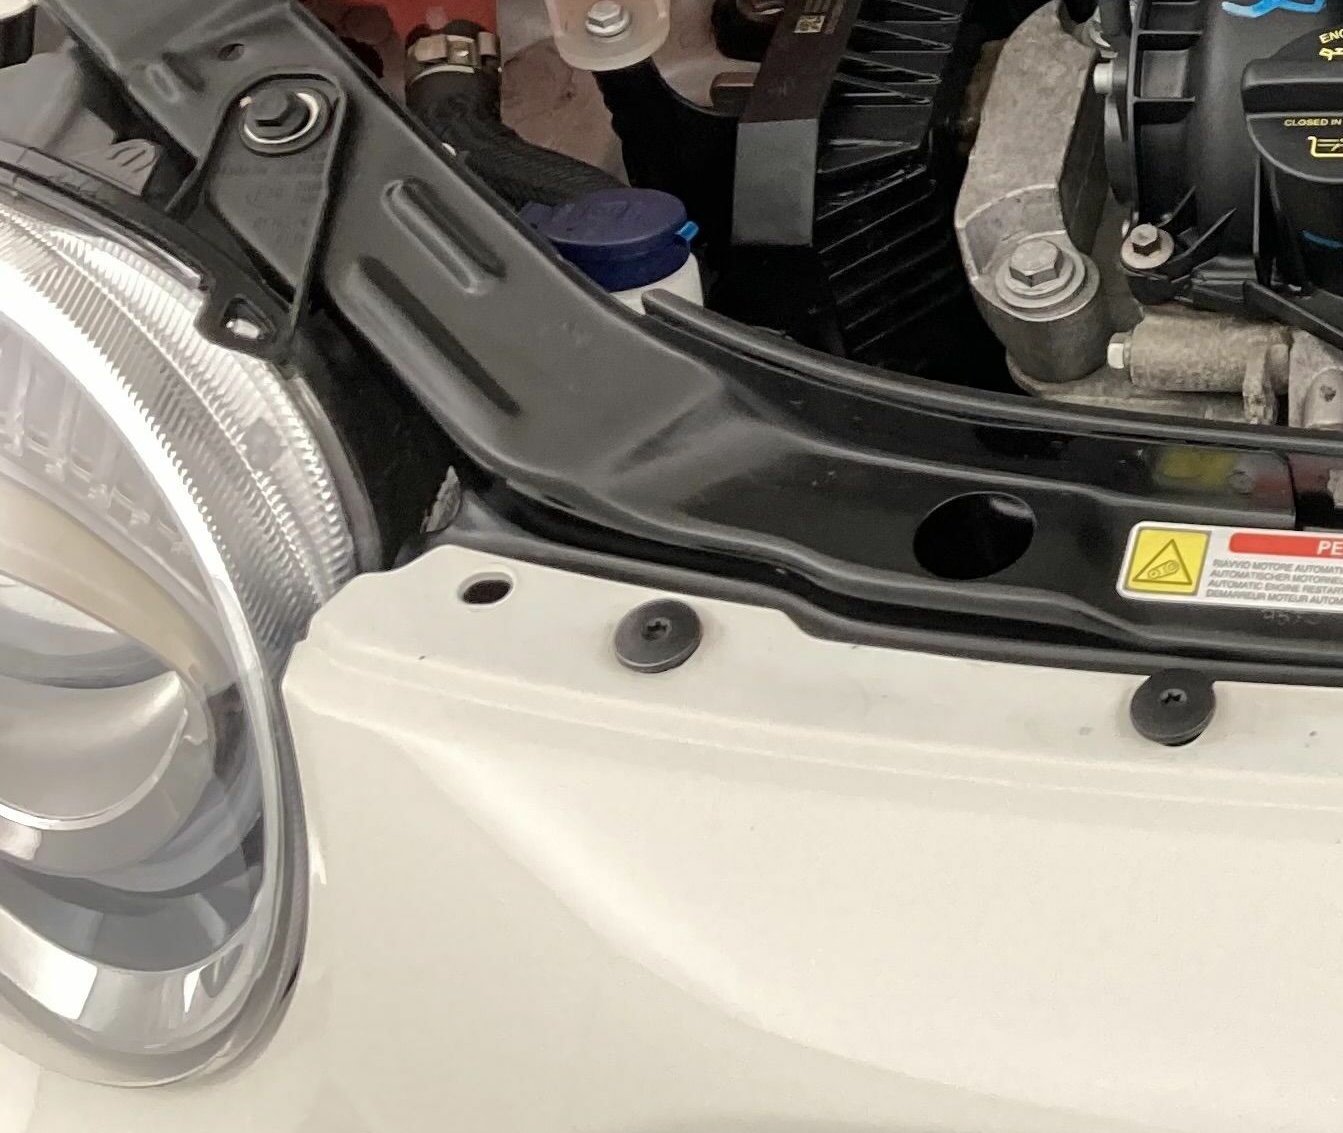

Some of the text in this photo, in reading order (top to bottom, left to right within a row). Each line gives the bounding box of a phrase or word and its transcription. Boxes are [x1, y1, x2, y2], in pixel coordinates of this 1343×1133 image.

[1283, 118, 1329, 127] CLOSED
[1330, 118, 1343, 127] IN
[1212, 558, 1251, 569] RIAVVIO
[1252, 562, 1294, 572] MOTORE
[1208, 579, 1264, 590] AUTOMATIC
[1264, 583, 1301, 593] ENGINE
[1206, 589, 1266, 601] DEMARREUR
[1267, 592, 1308, 603] MOTEUR
